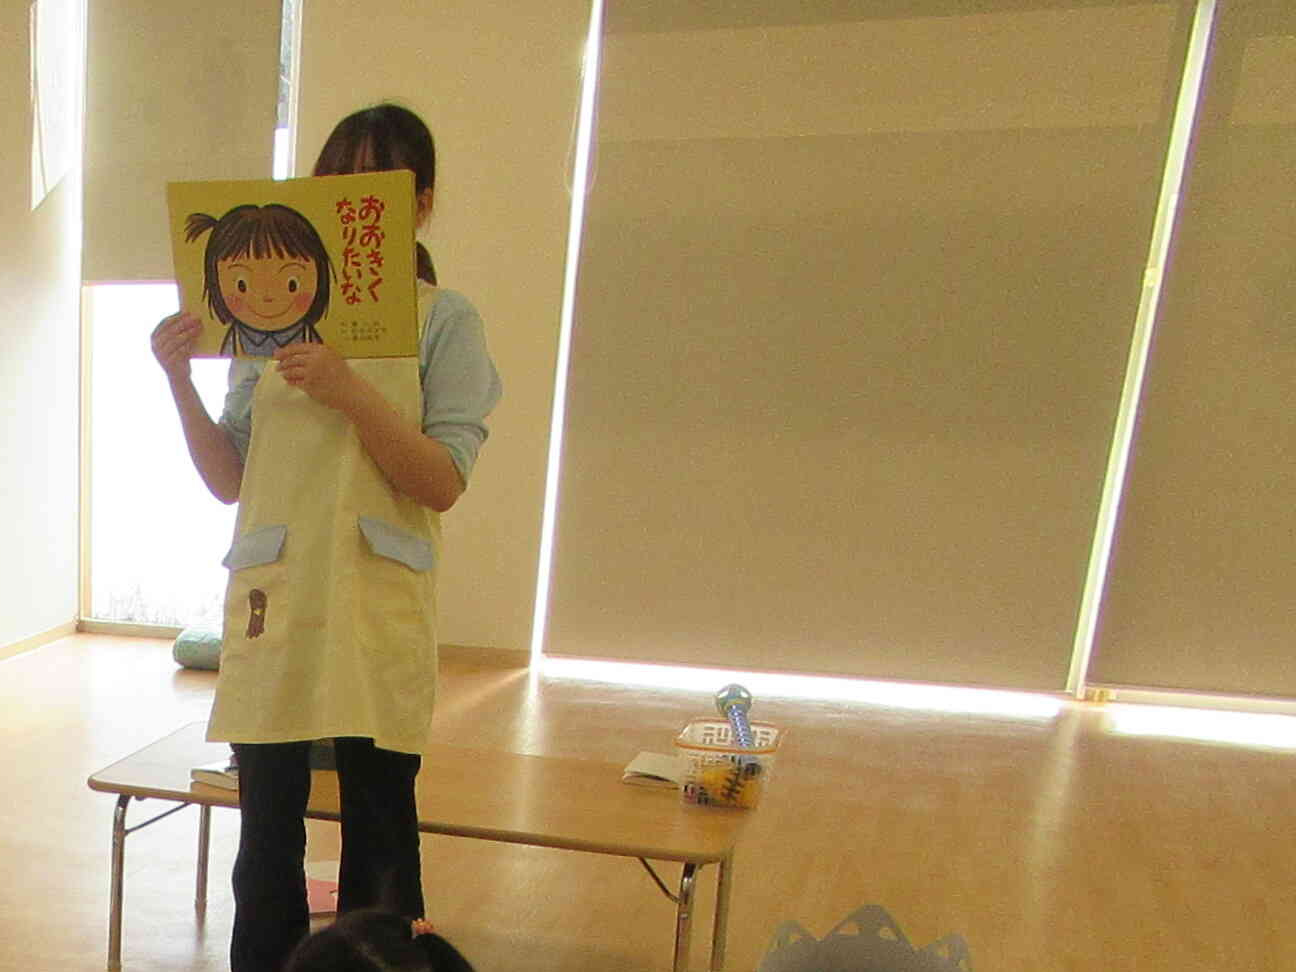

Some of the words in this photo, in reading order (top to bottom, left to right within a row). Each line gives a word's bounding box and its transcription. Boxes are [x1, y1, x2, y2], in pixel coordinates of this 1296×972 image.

[335, 197, 362, 305] なりたいな
[358, 194, 385, 303] おおきく
